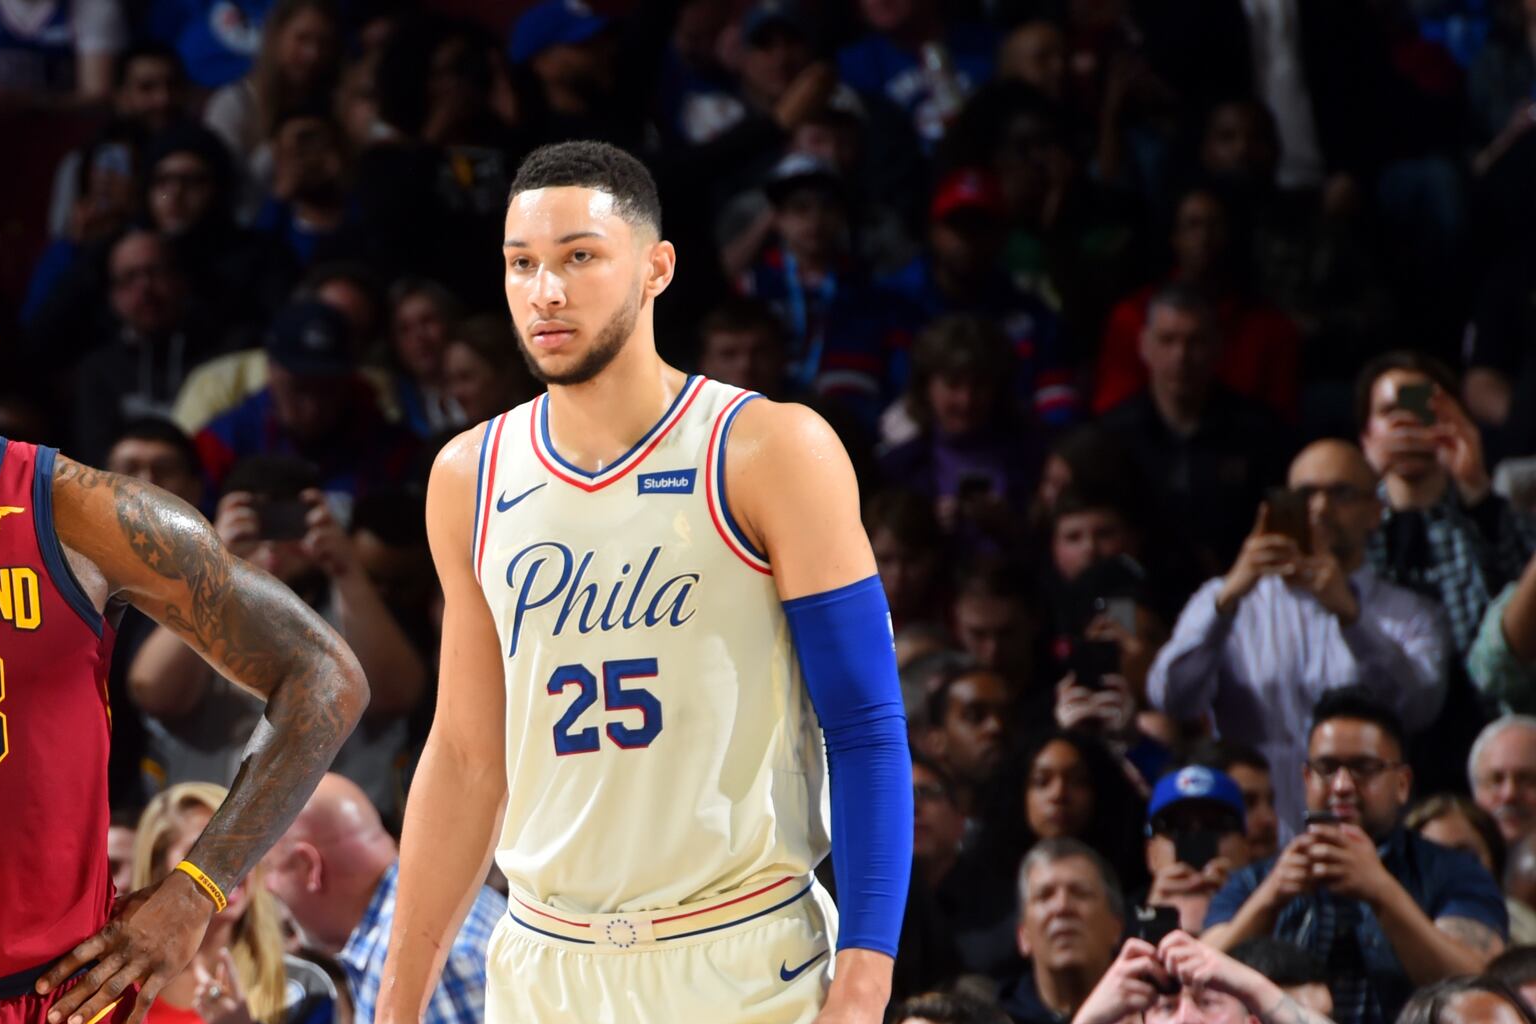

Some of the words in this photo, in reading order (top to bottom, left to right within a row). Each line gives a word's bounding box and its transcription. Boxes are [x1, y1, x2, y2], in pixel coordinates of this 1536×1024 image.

[644, 476, 690, 490] StubHub
[506, 541, 701, 659] Phila
[546, 657, 664, 757] 25
